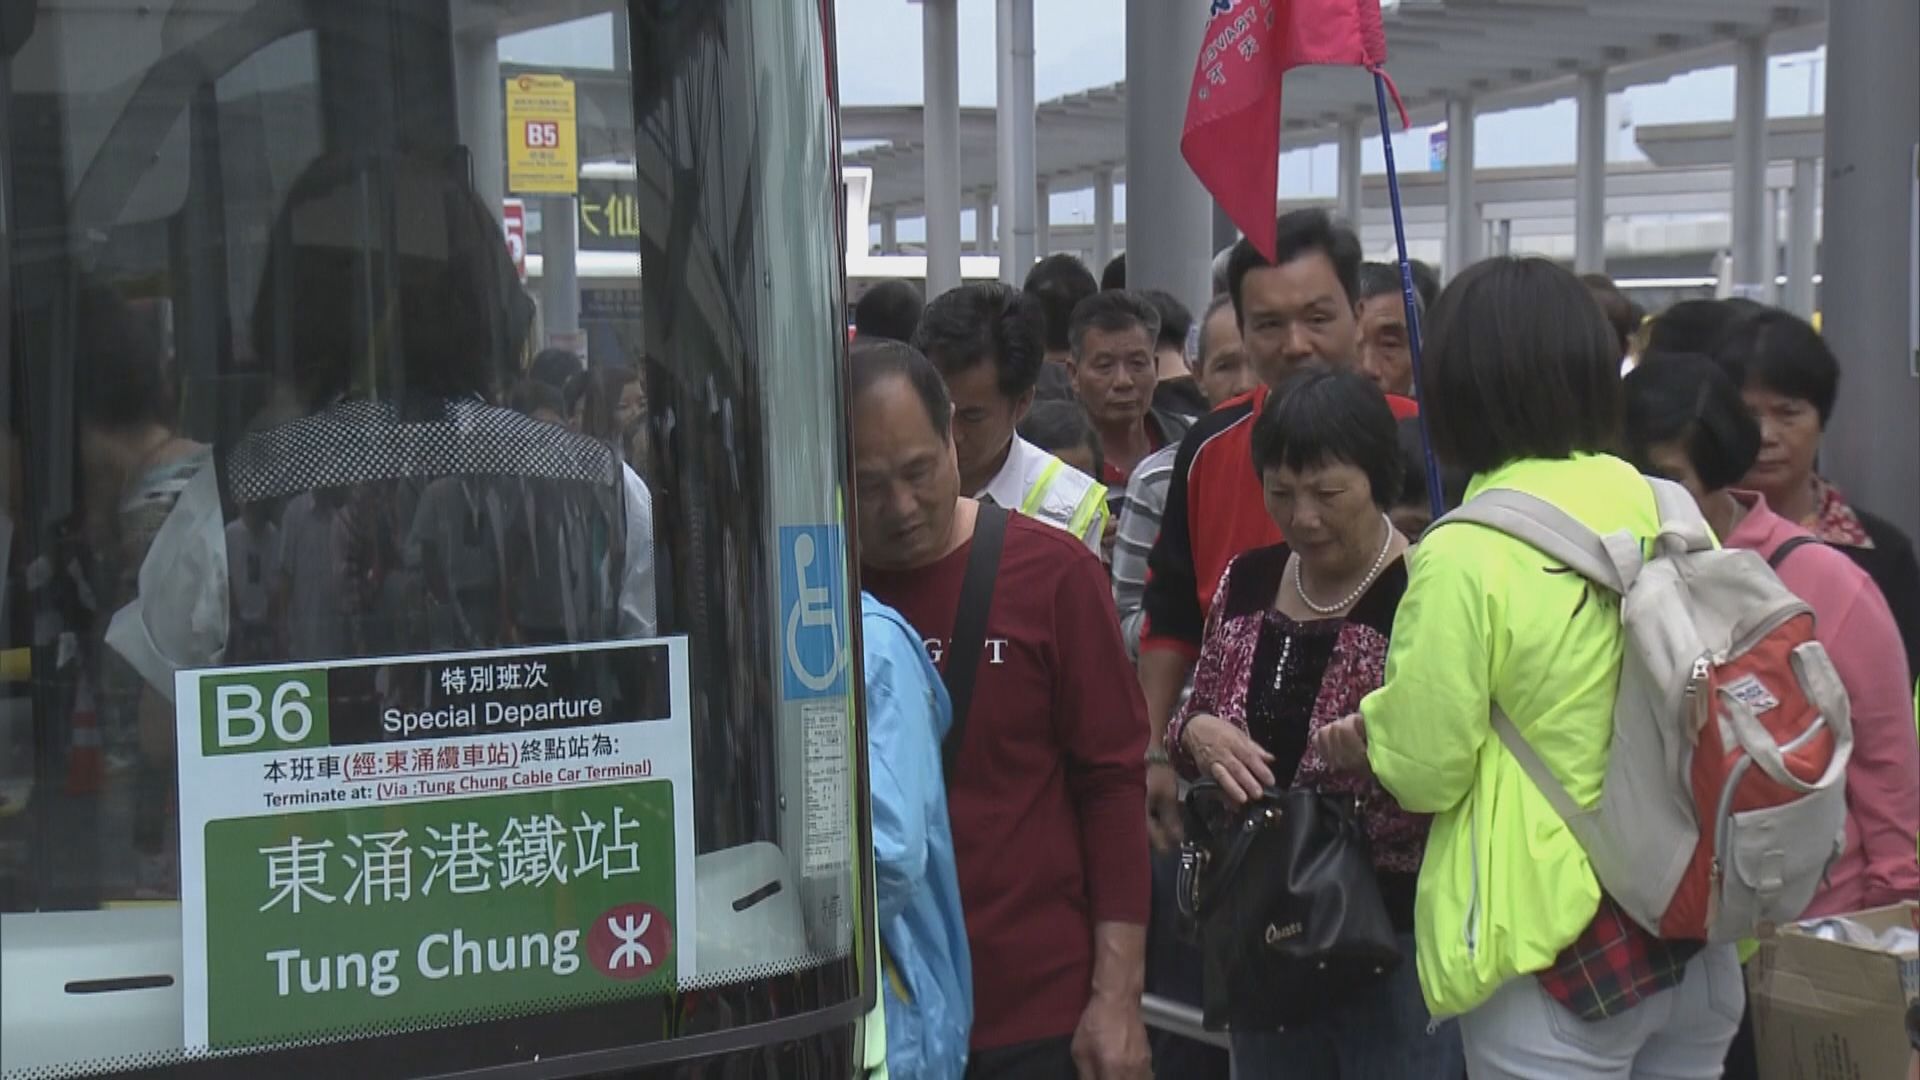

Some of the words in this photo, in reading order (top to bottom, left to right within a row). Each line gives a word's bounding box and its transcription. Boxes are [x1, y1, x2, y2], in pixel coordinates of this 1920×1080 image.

[528, 123, 556, 146] B5
[441, 661, 549, 695] 特別班次
[216, 680, 314, 748] B6
[384, 703, 476, 736] Special
[485, 698, 603, 727] Departure
[264, 788, 346, 807] Terminate
[351, 785, 372, 800] at:
[377, 781, 407, 800] (Via
[459, 774, 508, 791] Chung
[512, 769, 553, 786] Cable
[558, 767, 581, 782] Car
[585, 758, 653, 778] Terminal)
[259, 806, 640, 913] 東涌港鐵站
[266, 948, 400, 996] Tung
[417, 928, 581, 976] Chung
